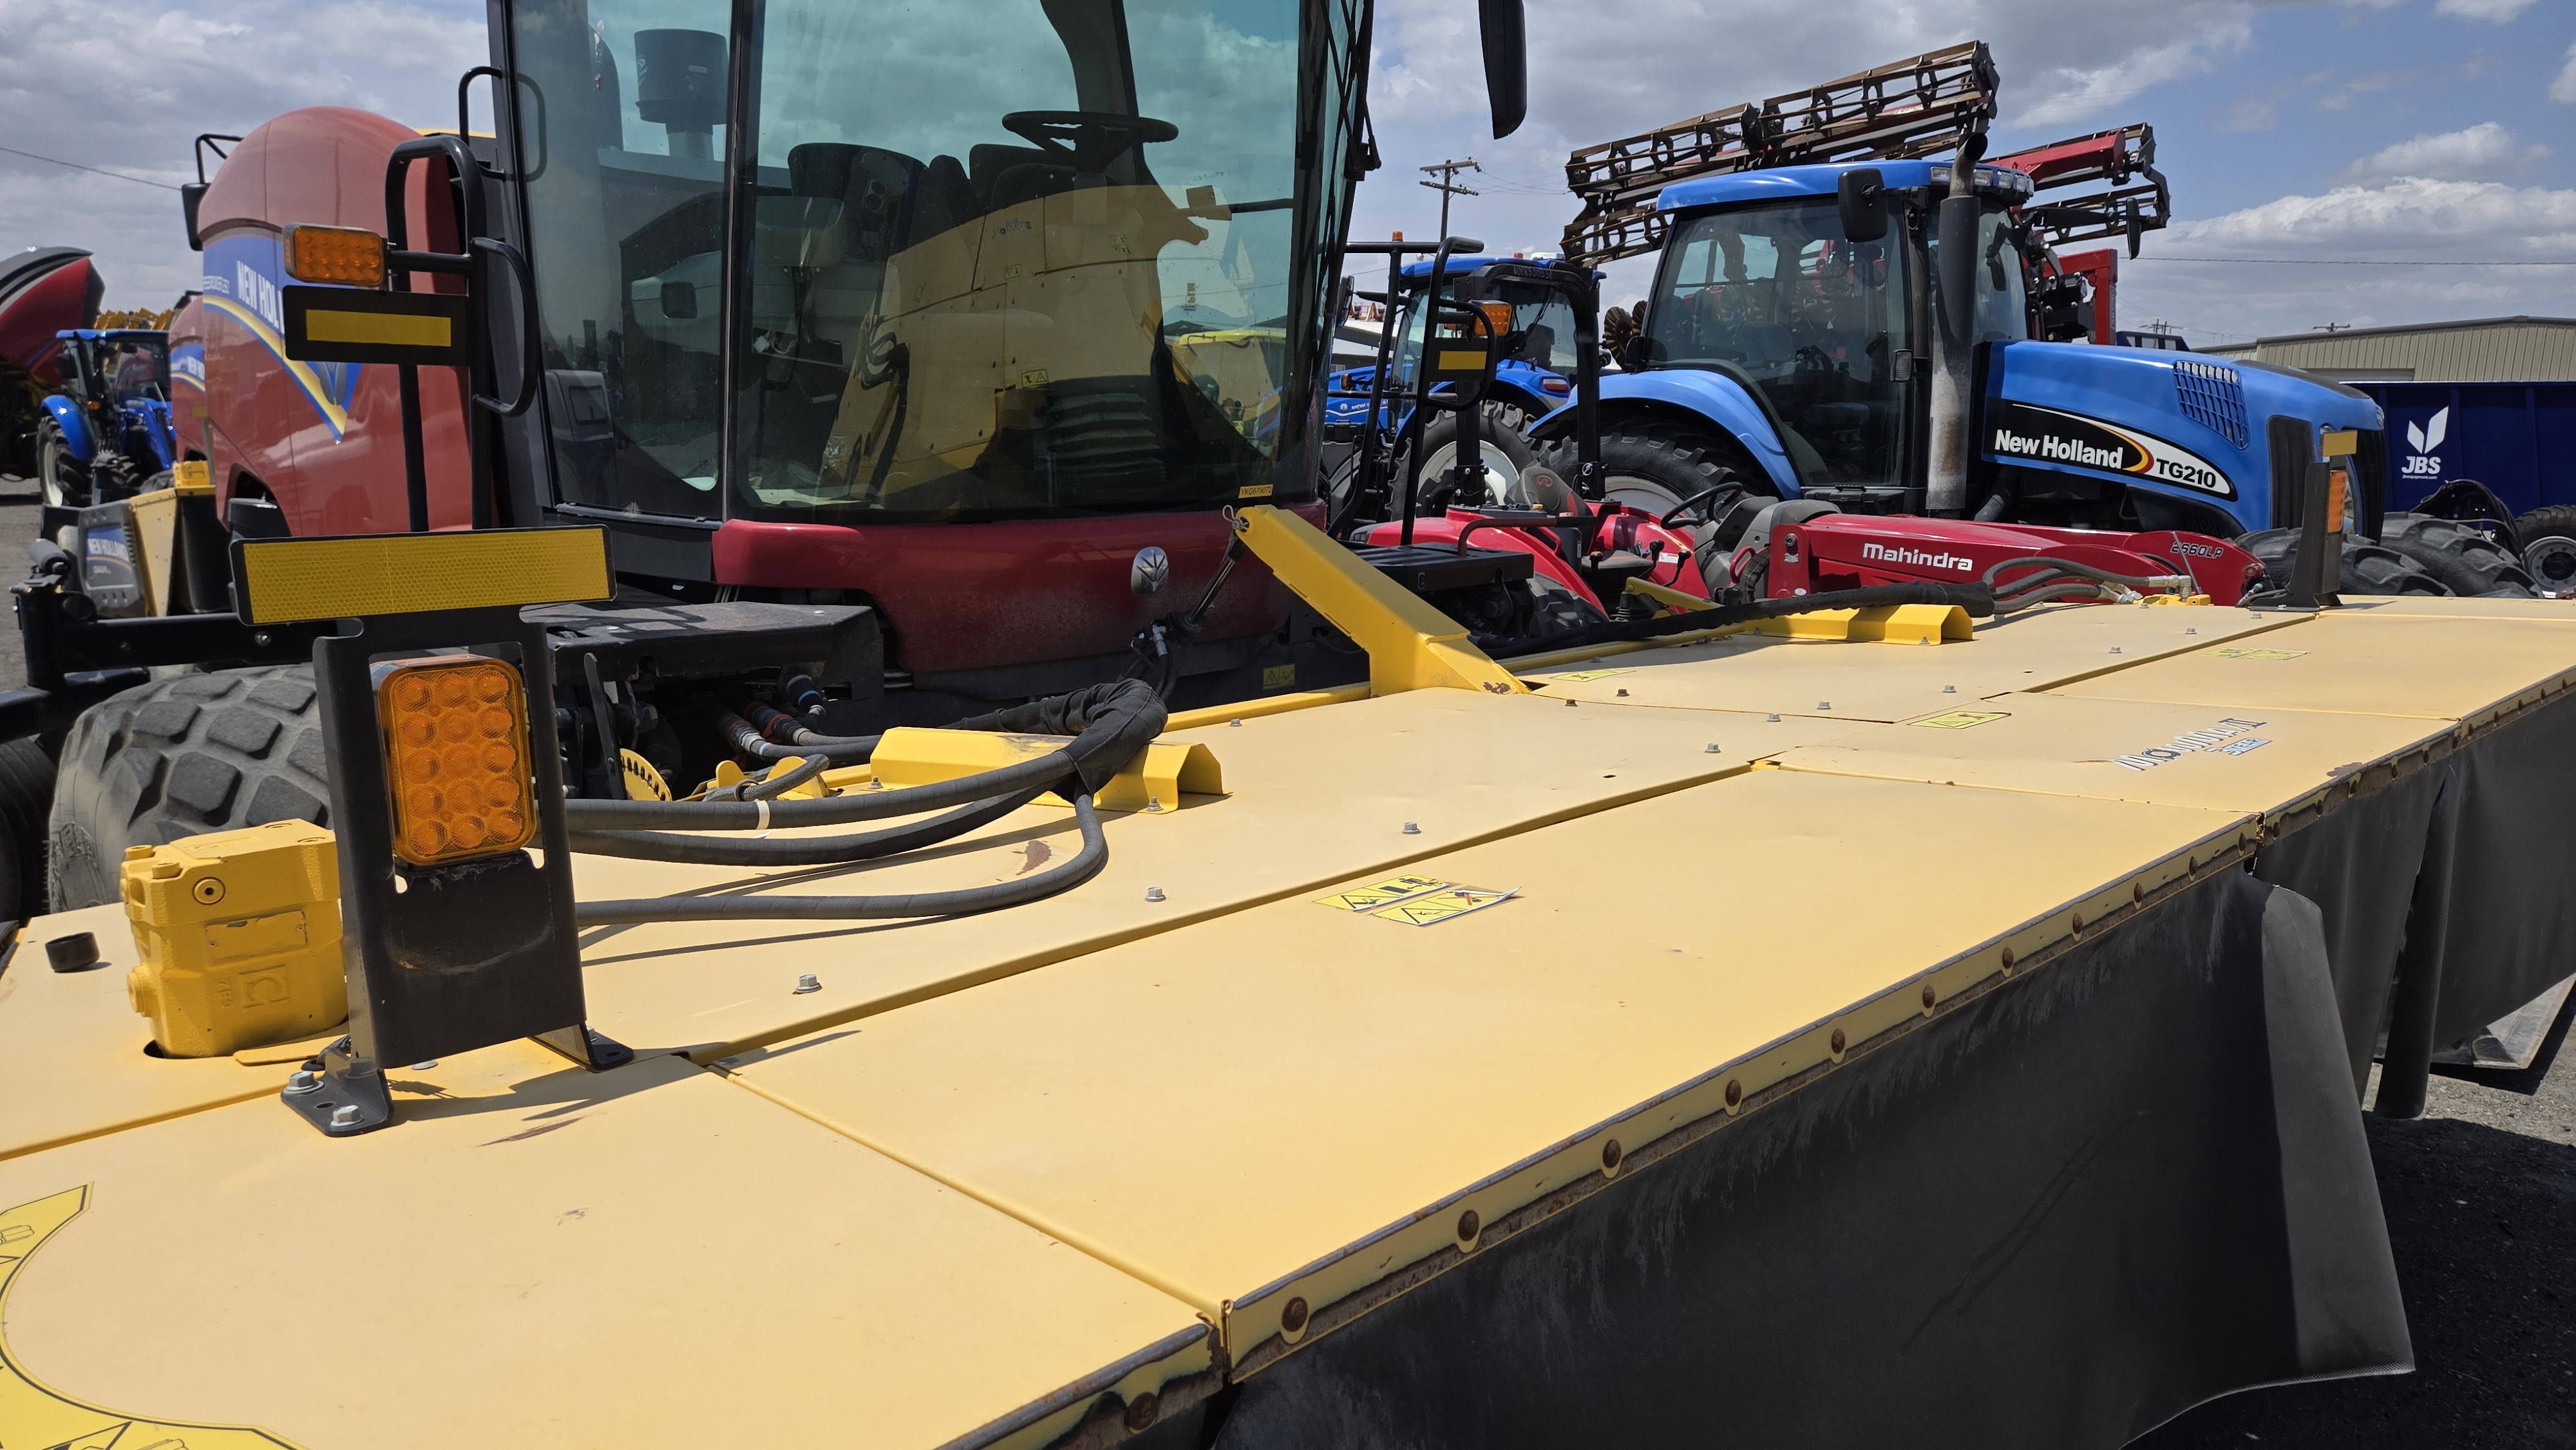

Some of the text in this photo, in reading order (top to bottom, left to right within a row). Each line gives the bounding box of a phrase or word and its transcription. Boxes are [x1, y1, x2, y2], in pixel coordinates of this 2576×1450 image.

[236, 260, 285, 335] NEW HOLL
[1995, 429, 2123, 469] New Holland
[2156, 458, 2217, 488] TG210
[2401, 456, 2441, 475] JBS
[1241, 486, 1272, 496] YKG679072
[88, 538, 129, 562] NEW HOLLAND
[1862, 543, 1973, 571] Mahindra
[2170, 541, 2224, 558] 2660LP
